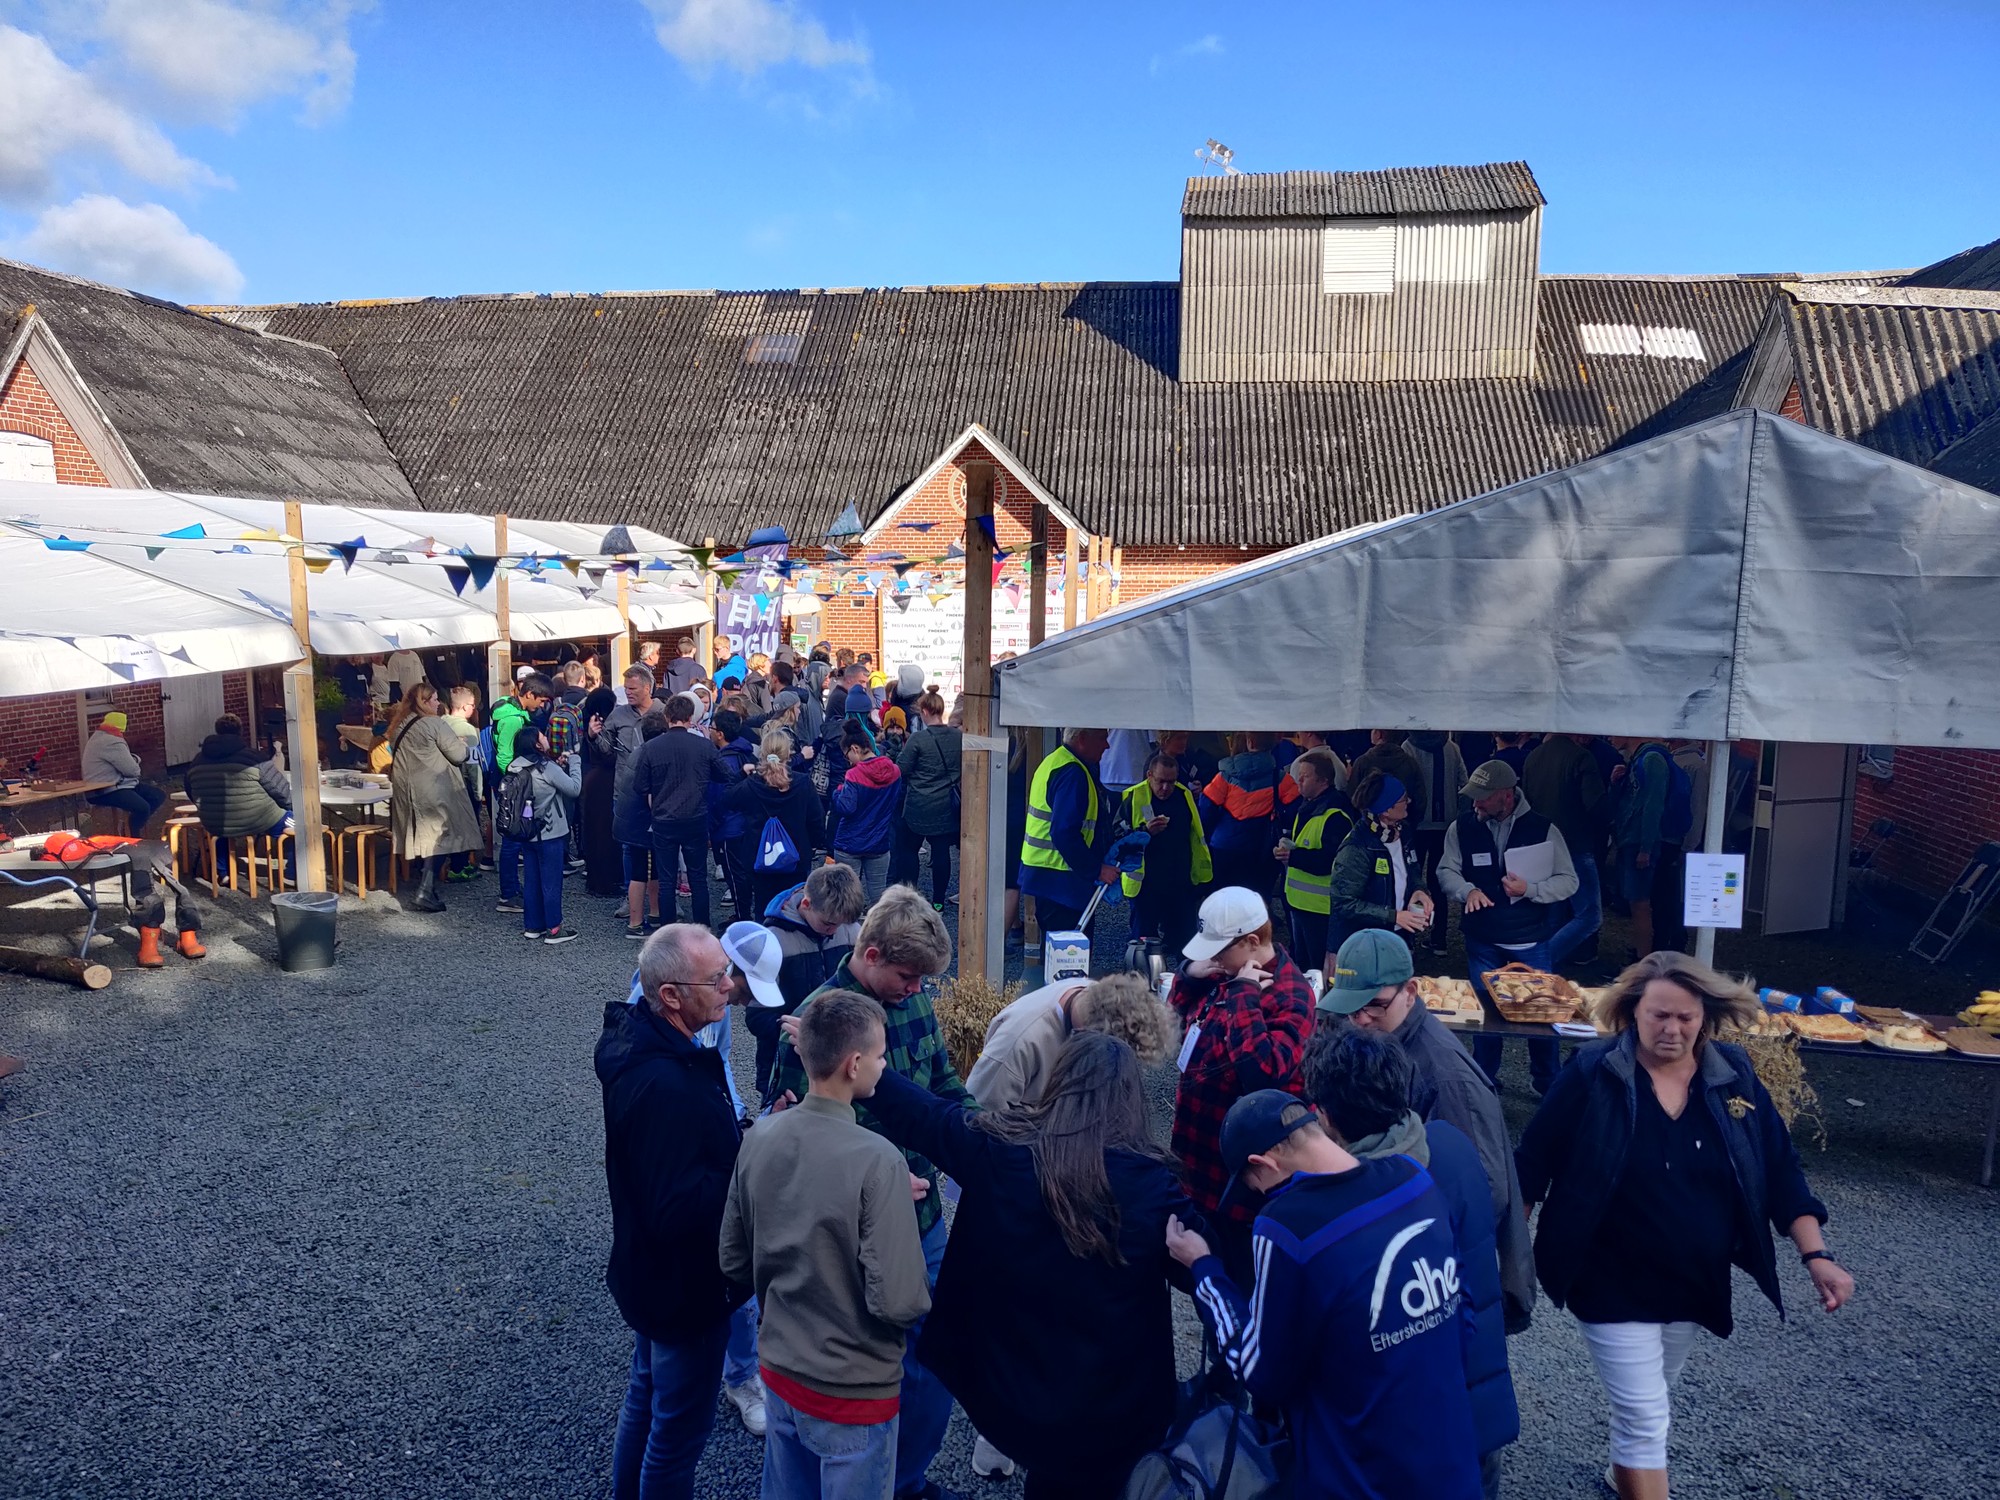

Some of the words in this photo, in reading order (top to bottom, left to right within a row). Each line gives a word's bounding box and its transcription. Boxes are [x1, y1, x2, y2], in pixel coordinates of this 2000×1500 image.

[727, 631, 779, 660] PGU
[1401, 1256, 1460, 1318] dhe
[1371, 1313, 1443, 1353] Efterskolen
